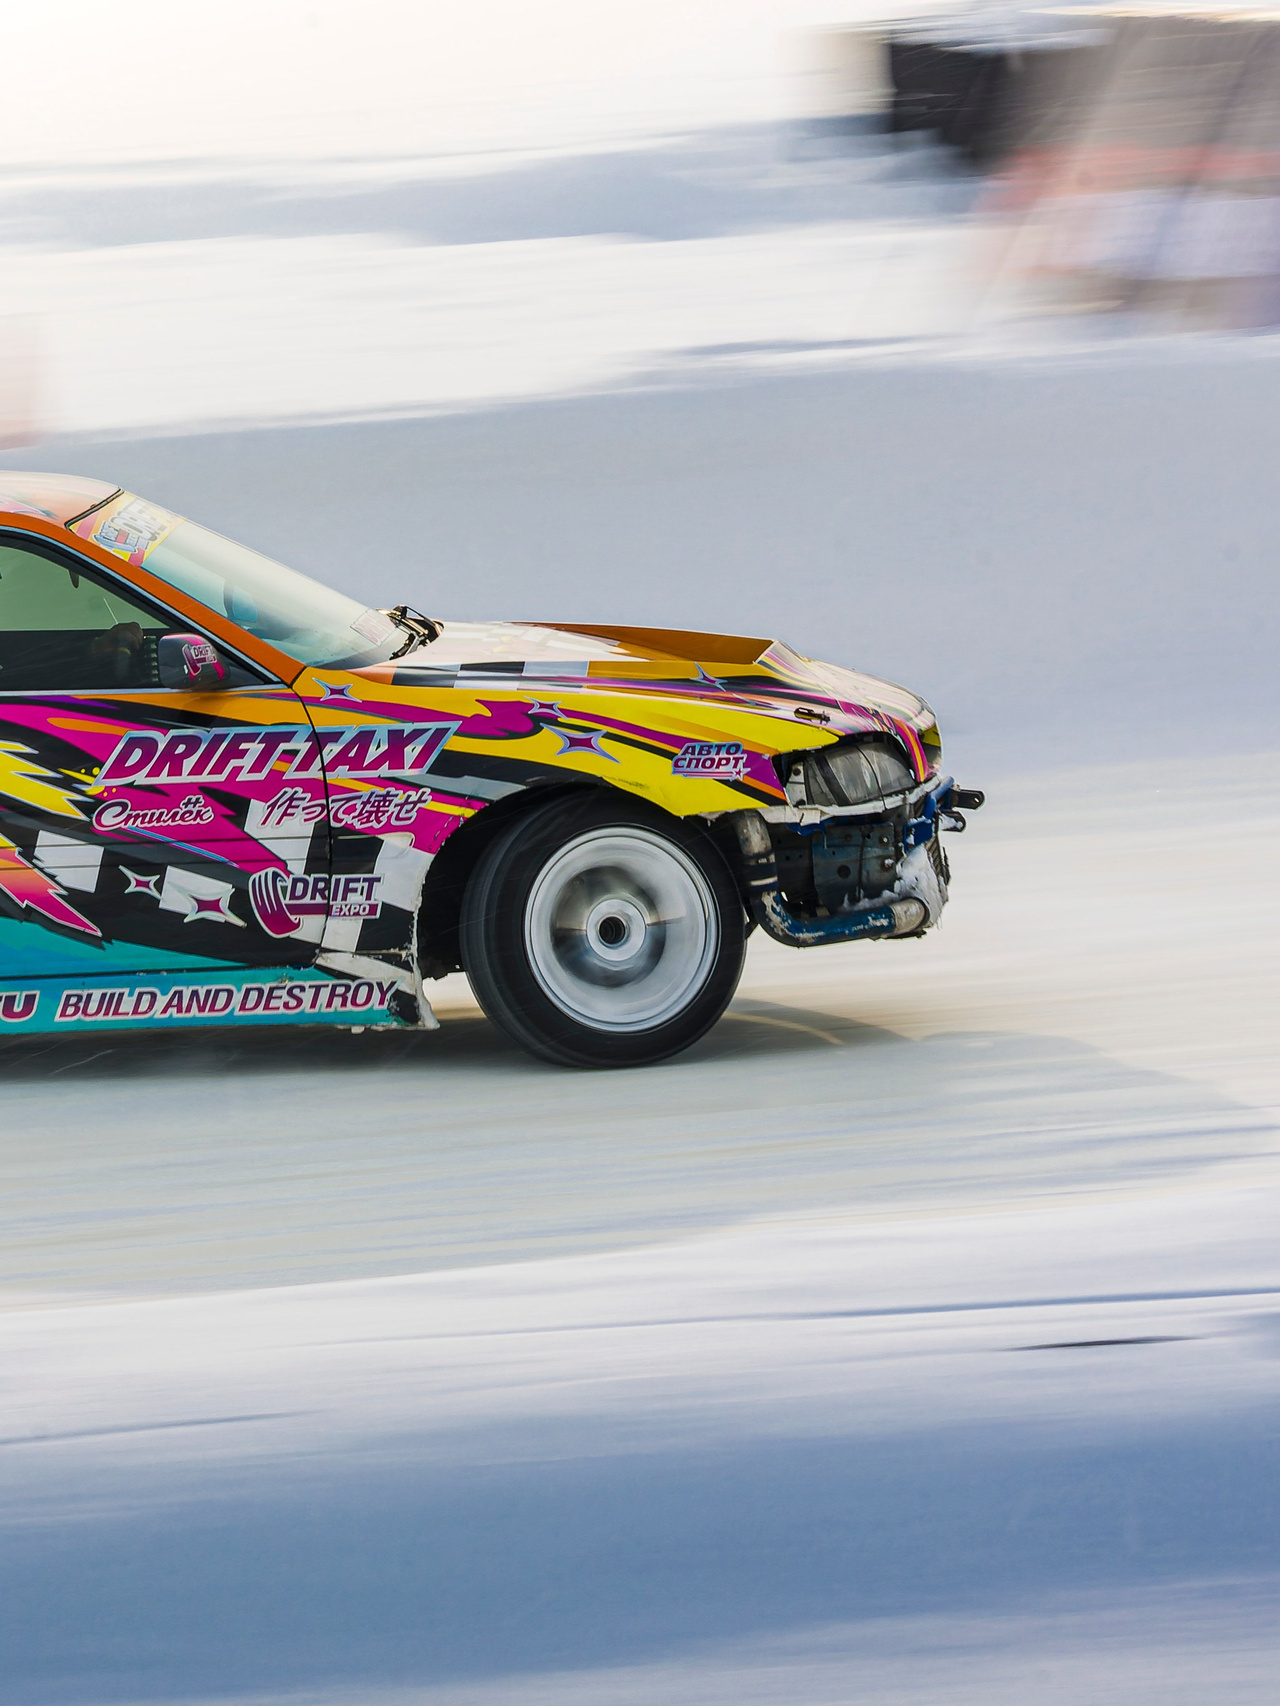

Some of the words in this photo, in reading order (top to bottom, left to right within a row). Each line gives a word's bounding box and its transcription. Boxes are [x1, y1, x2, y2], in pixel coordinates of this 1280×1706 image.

[100, 729, 300, 783] DRIFT
[293, 727, 450, 776] TAXI
[673, 756, 745, 769] СПОРТ
[681, 743, 741, 756] АВТО
[94, 796, 214, 828] Стилёк
[260, 789, 429, 826] 作って壊せ
[288, 876, 382, 902] DRIFT
[331, 904, 370, 916] EXPO
[58, 988, 159, 1019] BUILD
[159, 986, 235, 1016] AND
[237, 979, 399, 1013] DESTROY
